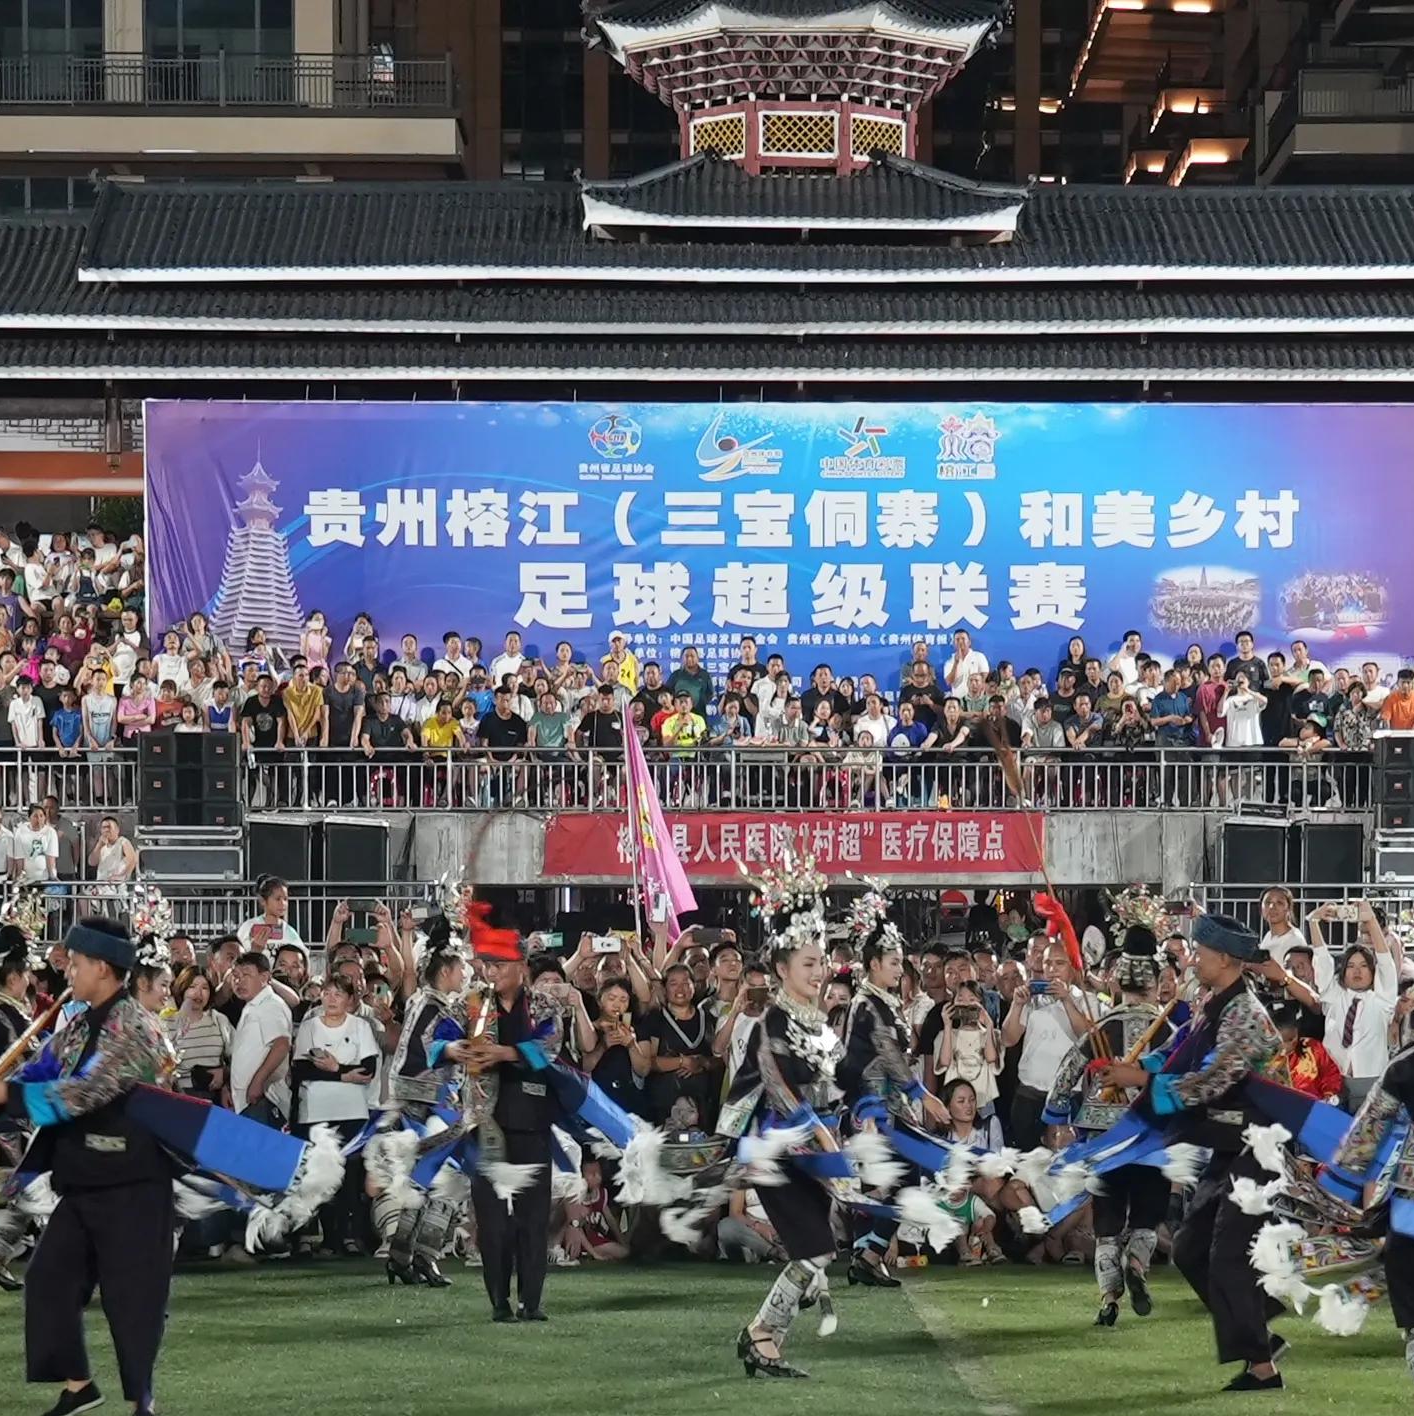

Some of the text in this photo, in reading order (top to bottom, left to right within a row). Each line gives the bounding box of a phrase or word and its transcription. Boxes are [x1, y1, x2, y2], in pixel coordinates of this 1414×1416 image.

[303, 488, 1300, 549] 贵州榕江（三宝侗寨）和美乡村
[513, 561, 1088, 630] 足球超级联赛
[670, 633, 779, 645] 中国足球发展金会
[616, 820, 1006, 863] 榕县人民医院“村超”医疗保障点
